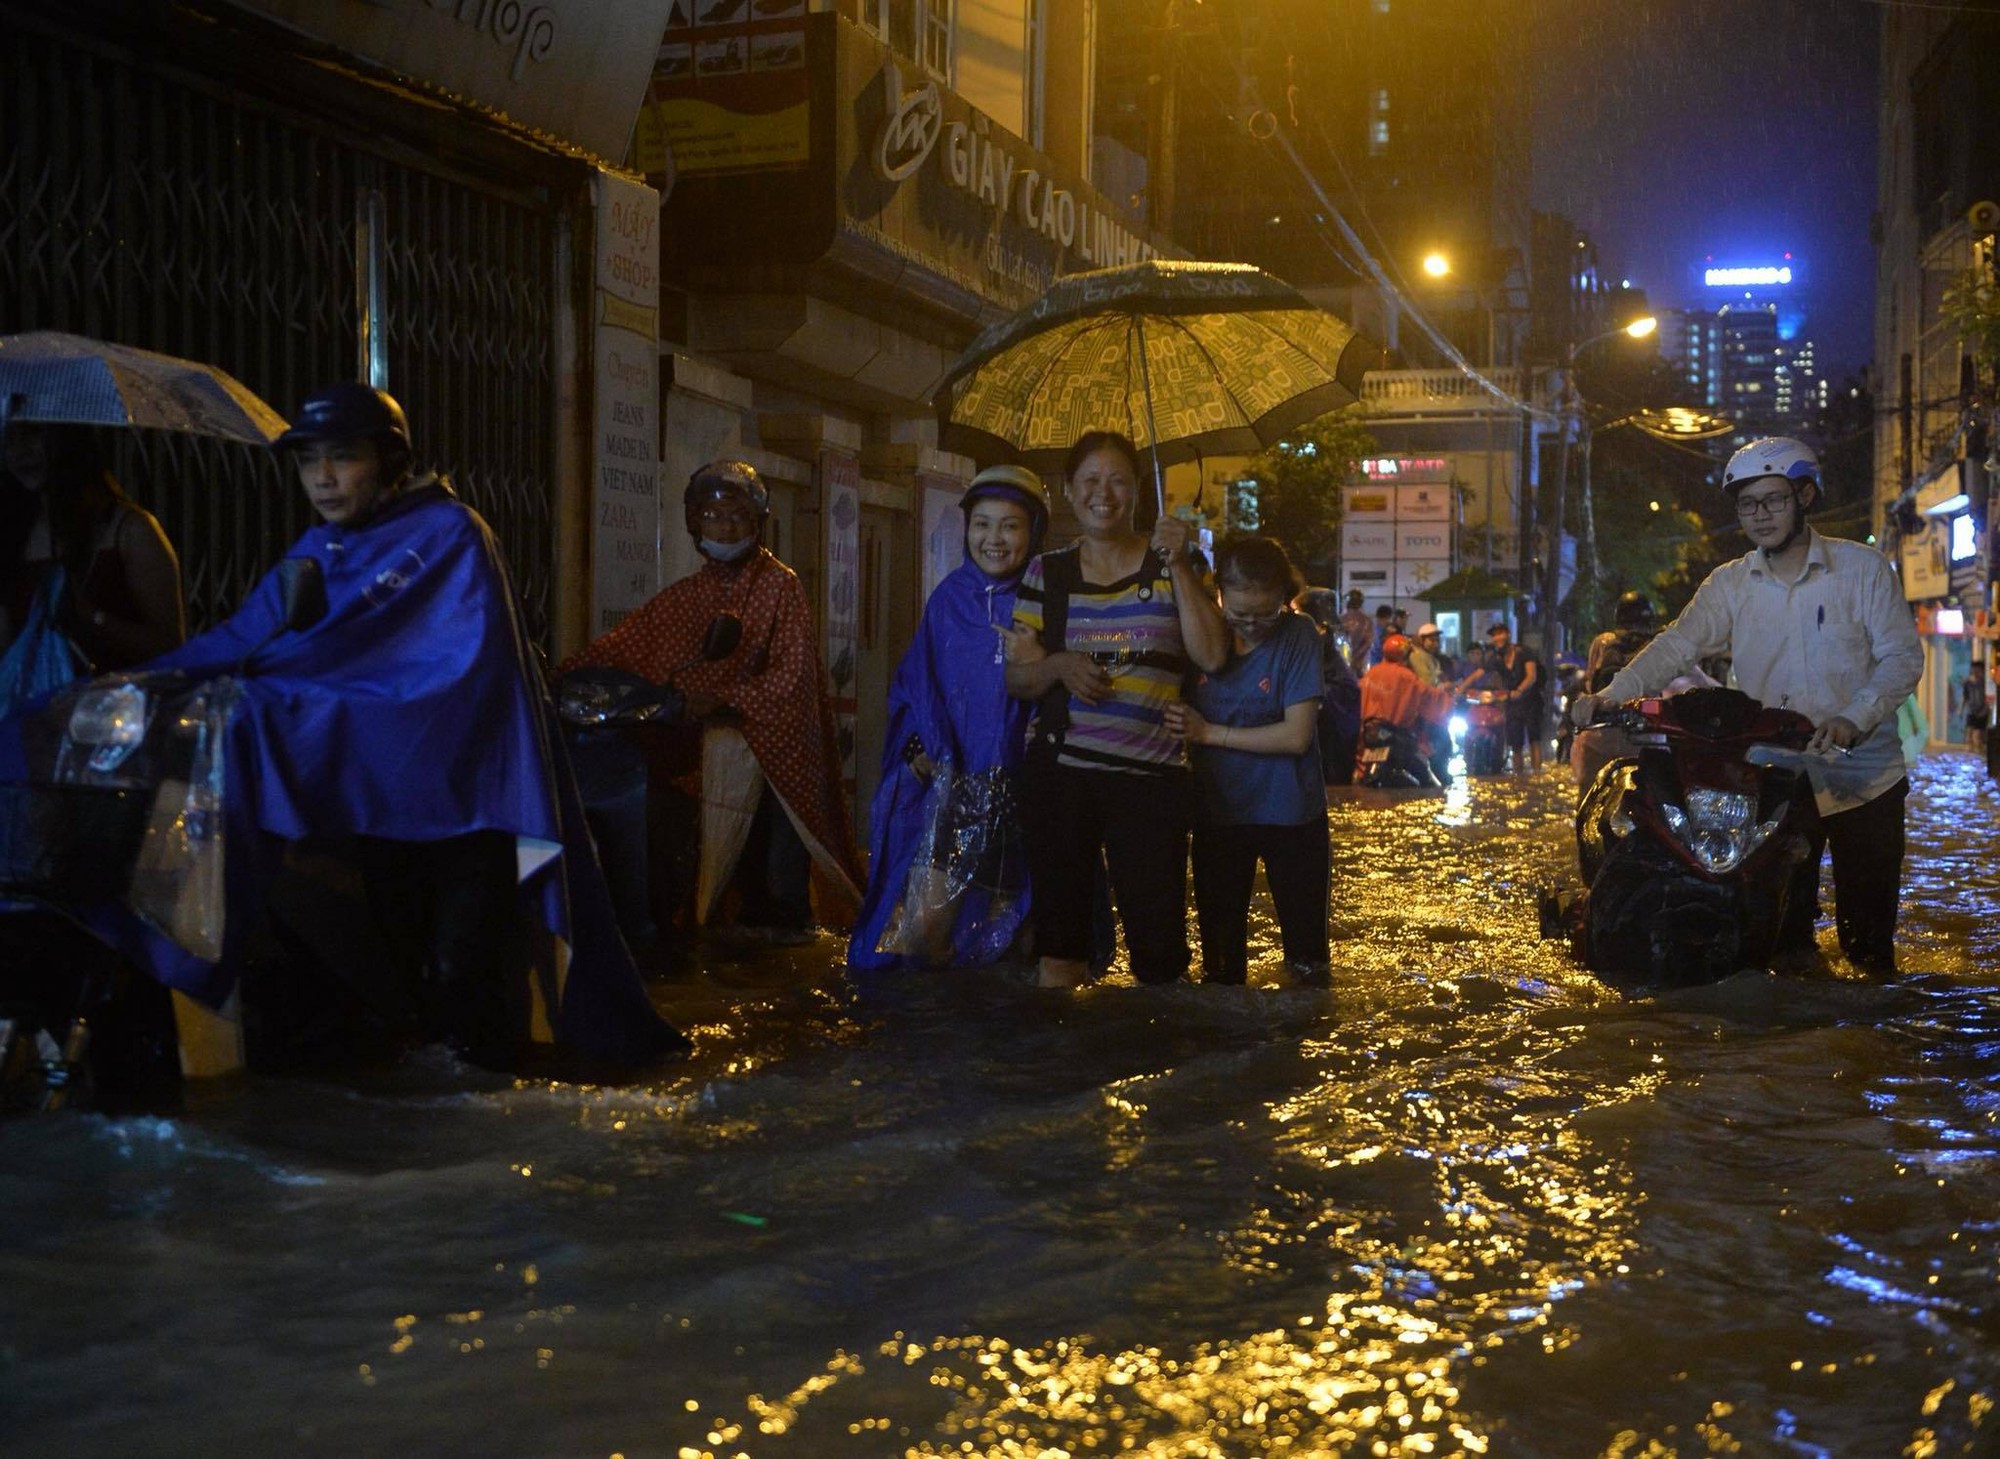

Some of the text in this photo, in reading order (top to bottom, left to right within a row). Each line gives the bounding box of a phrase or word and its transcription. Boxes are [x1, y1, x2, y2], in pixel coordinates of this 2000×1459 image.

[1025, 168, 1076, 248] CAO
[612, 254, 652, 289] SHOP
[612, 401, 645, 427] JEANS
[606, 434, 650, 462] MADE IN
[628, 472, 654, 497] NAM
[601, 502, 637, 531] ZARA
[616, 539, 657, 563] MANGO
[1405, 536, 1442, 547] TOTO
